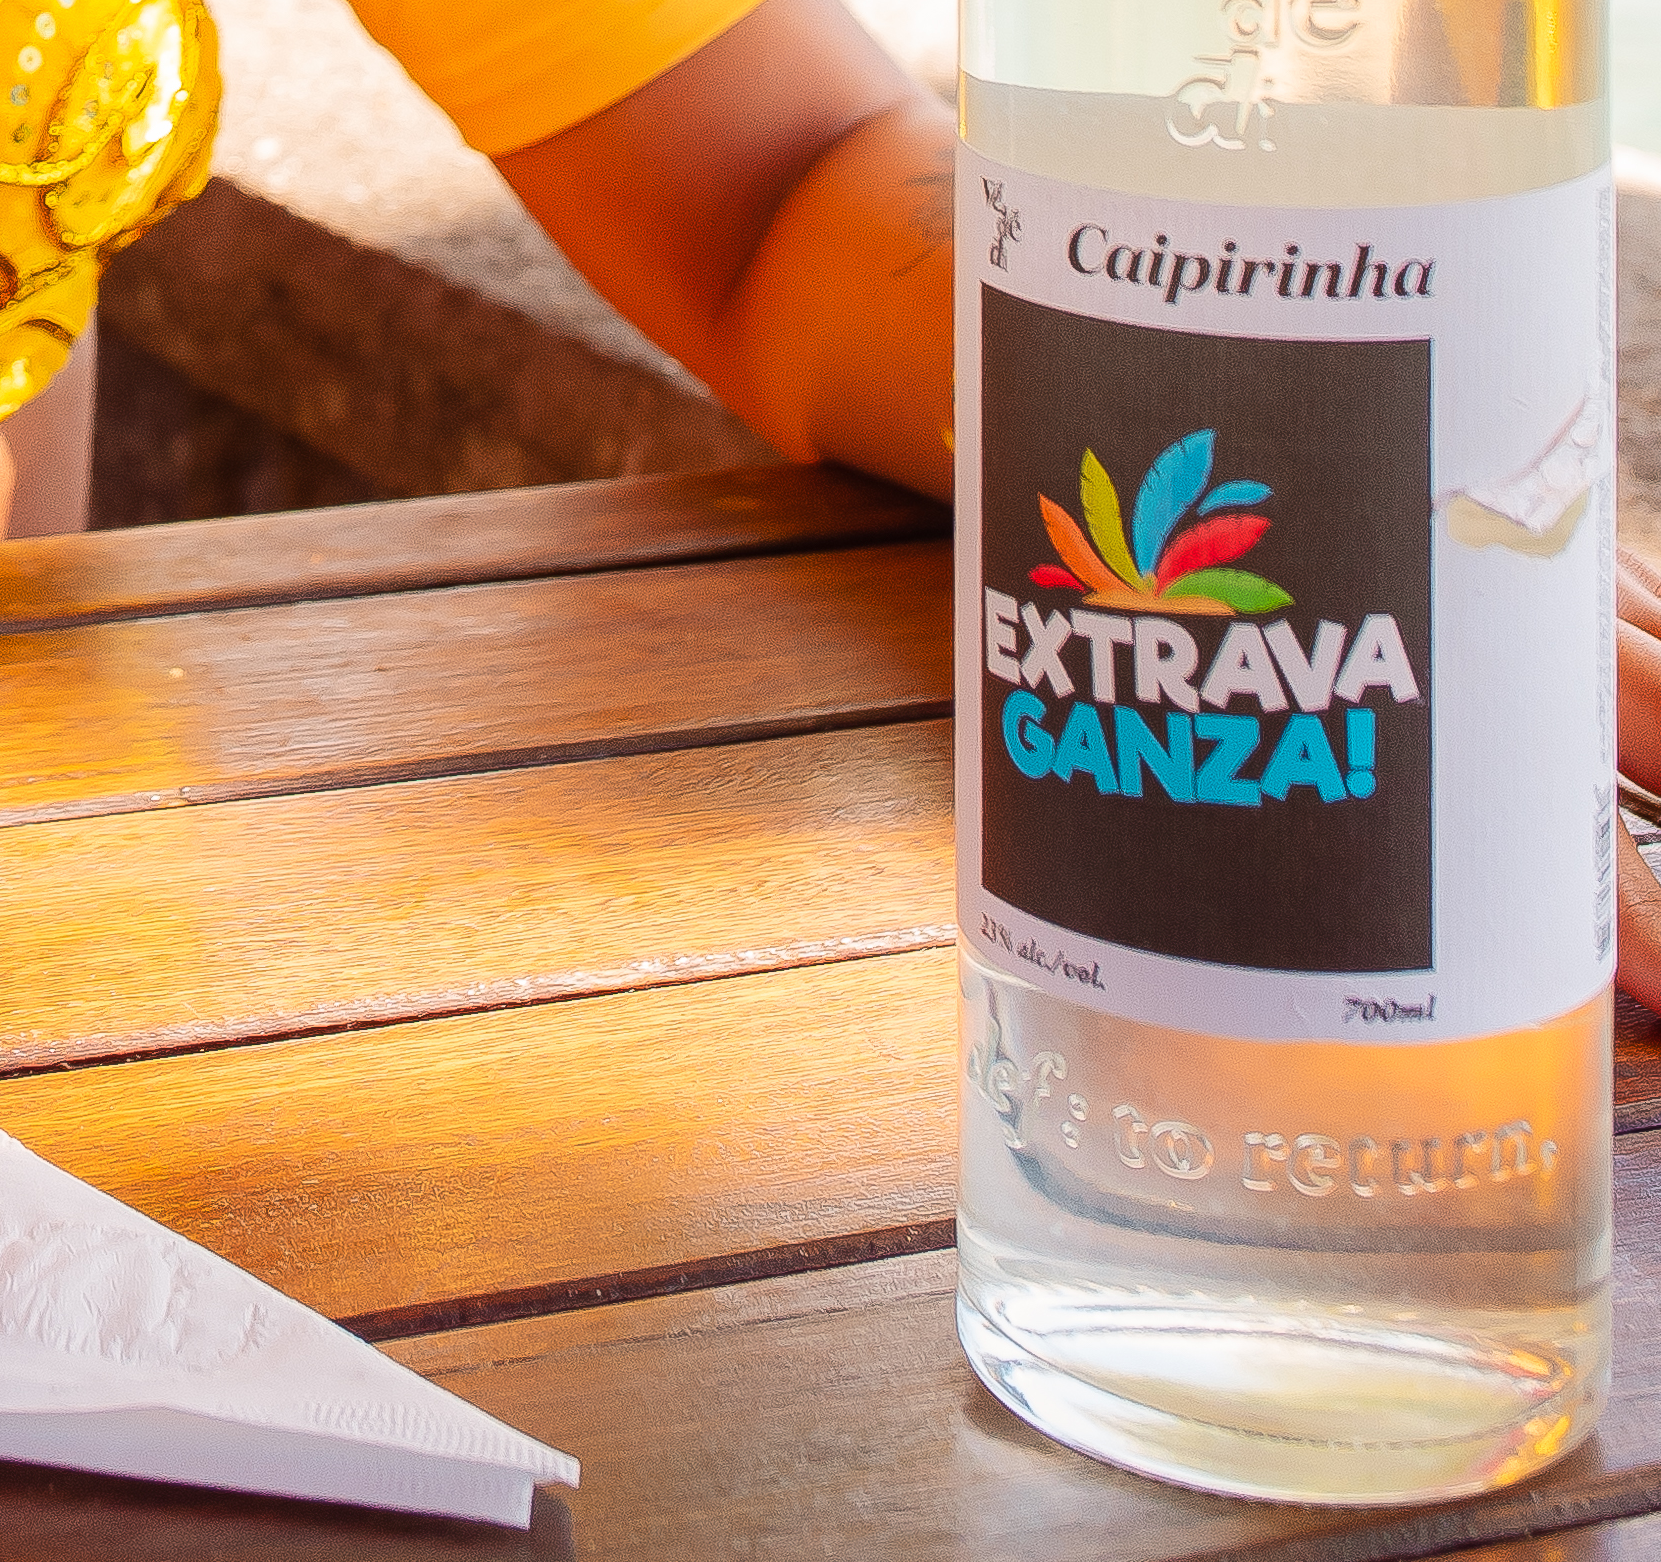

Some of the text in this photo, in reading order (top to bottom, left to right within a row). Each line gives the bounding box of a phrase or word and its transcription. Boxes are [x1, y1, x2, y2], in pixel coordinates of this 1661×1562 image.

[1066, 223, 1437, 305] Caipirinha
[984, 586, 1421, 713] EXTRAVA
[1001, 689, 1377, 807] GANZA!
[1341, 993, 1437, 1025] 700ml
[1111, 1103, 1216, 1181] to
